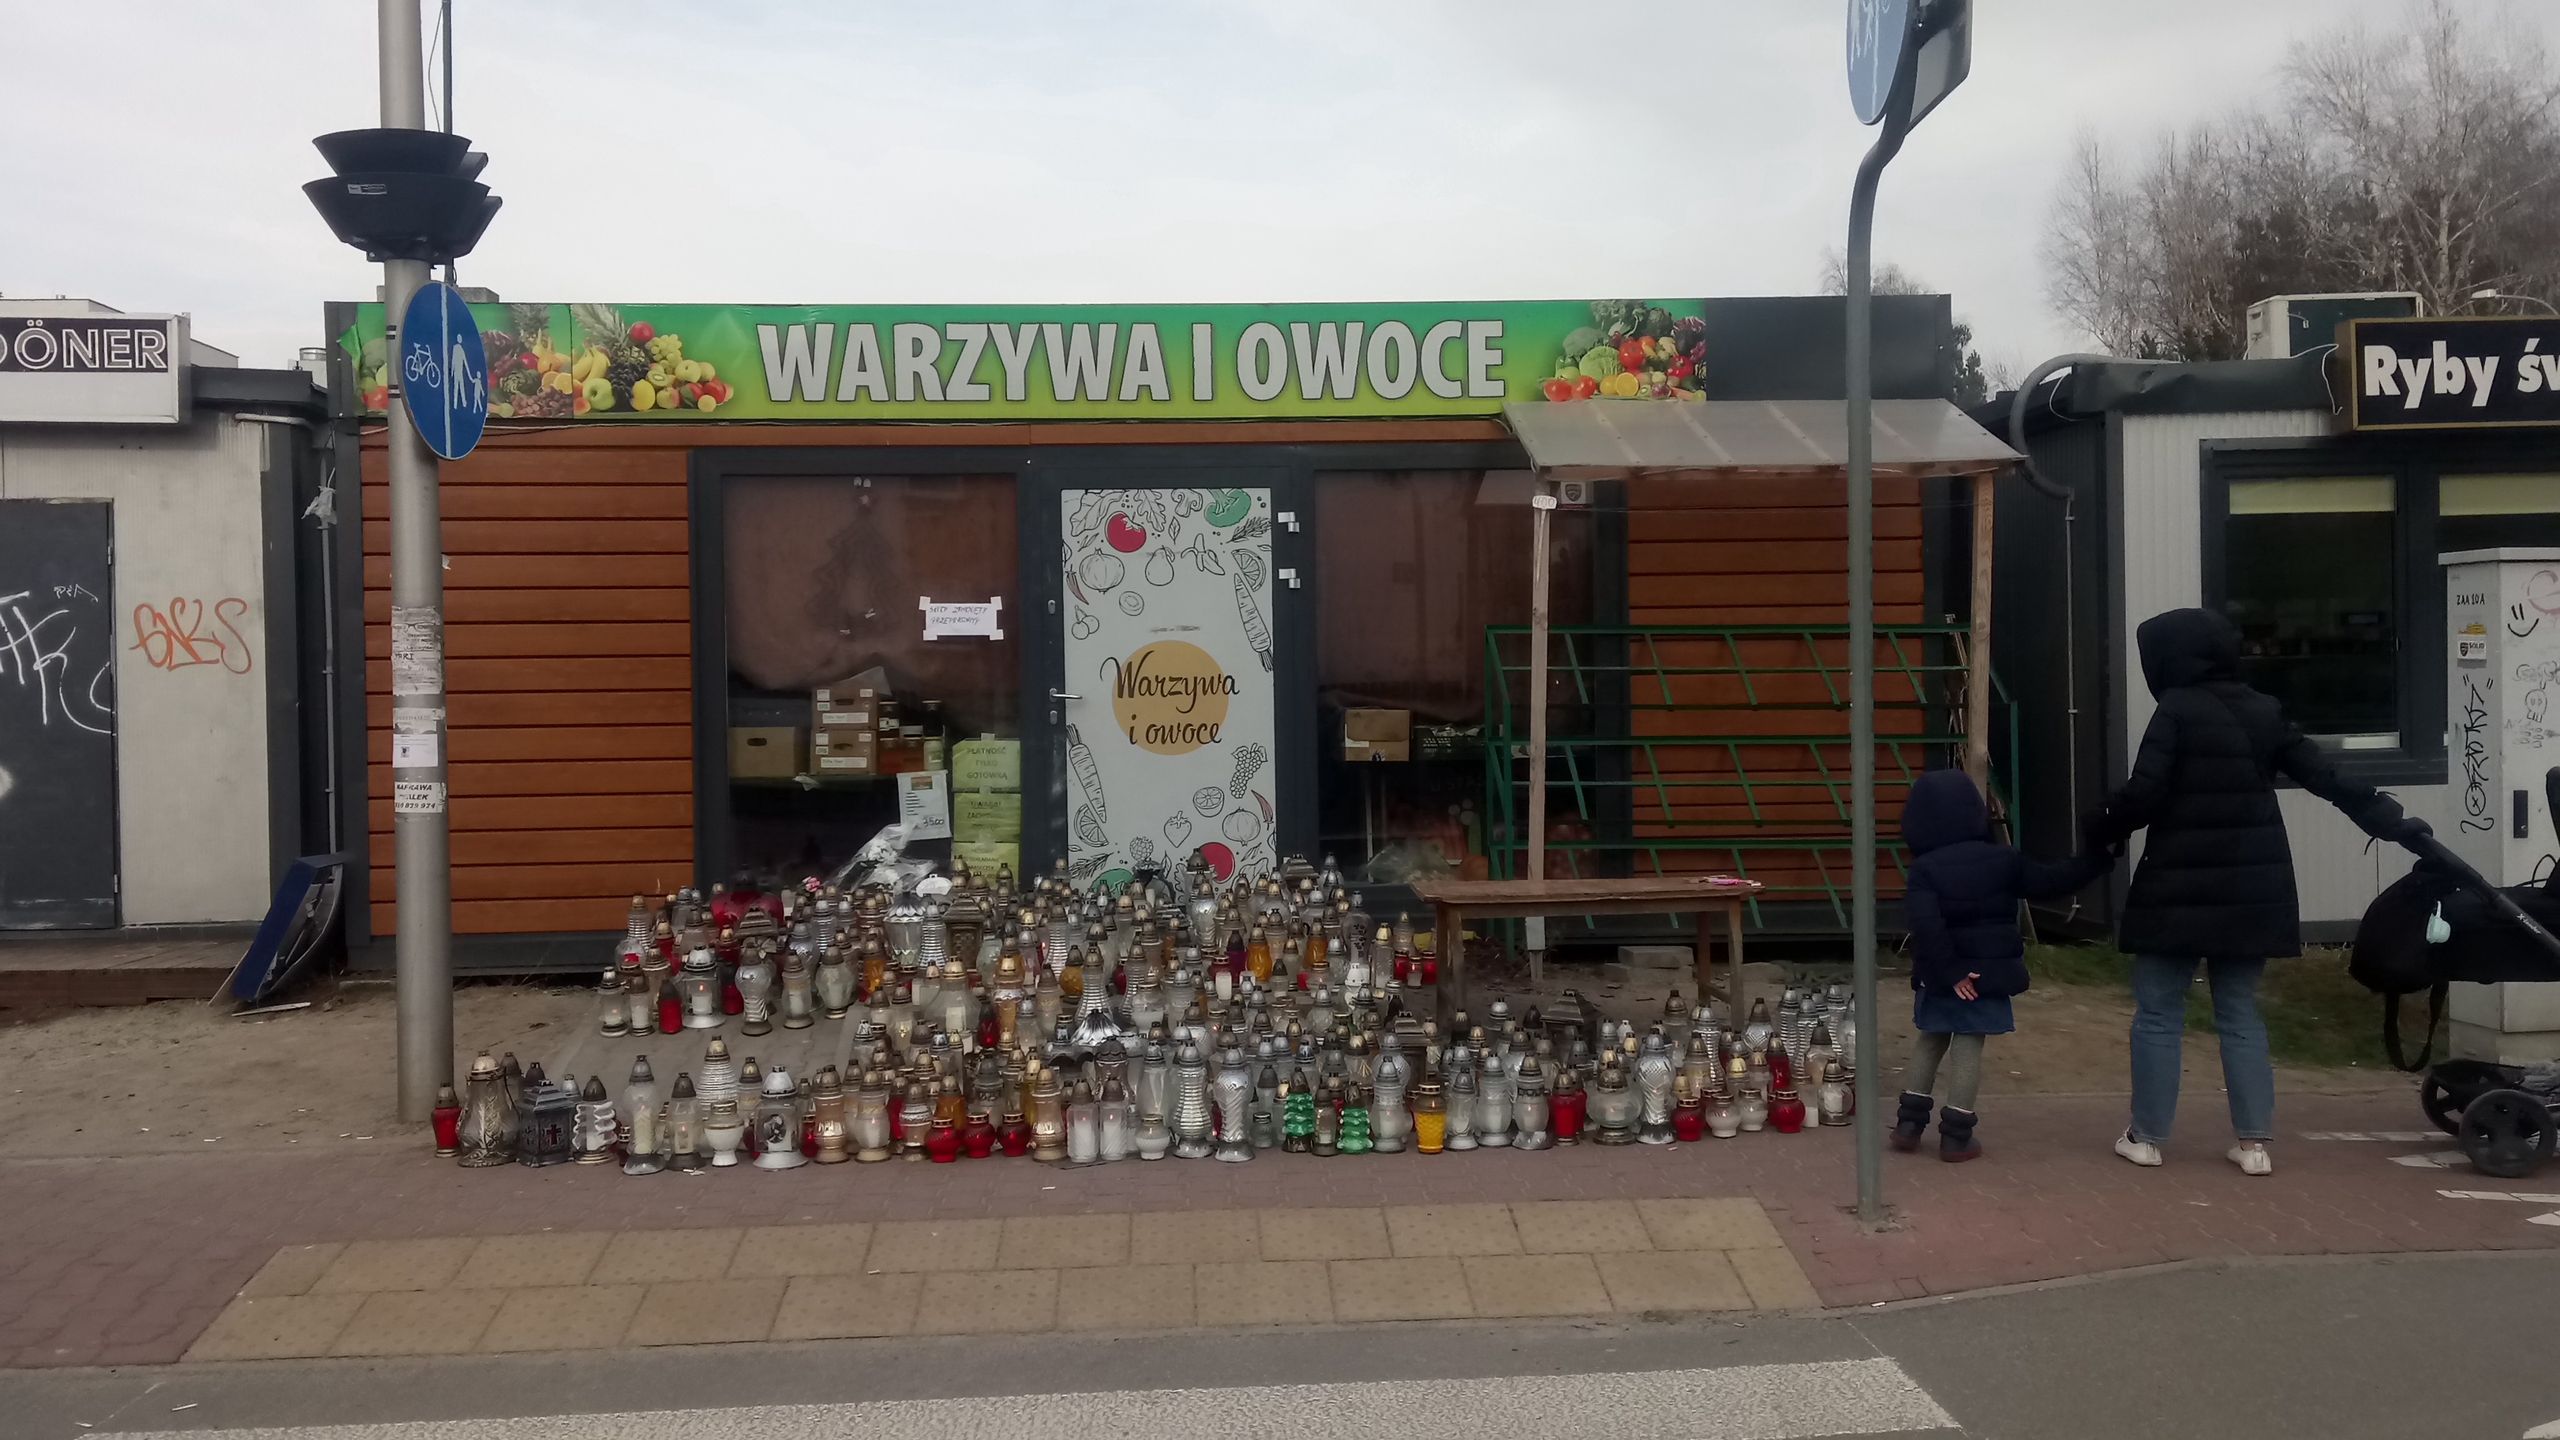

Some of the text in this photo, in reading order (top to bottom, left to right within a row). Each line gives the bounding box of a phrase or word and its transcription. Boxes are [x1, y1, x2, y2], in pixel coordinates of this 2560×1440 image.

[756, 319, 1506, 402] WARZYWA I OWOCE
[2364, 340, 2500, 409] Ryby
[1099, 650, 1240, 714] Warzywa
[1128, 713, 1223, 745] i owoce
